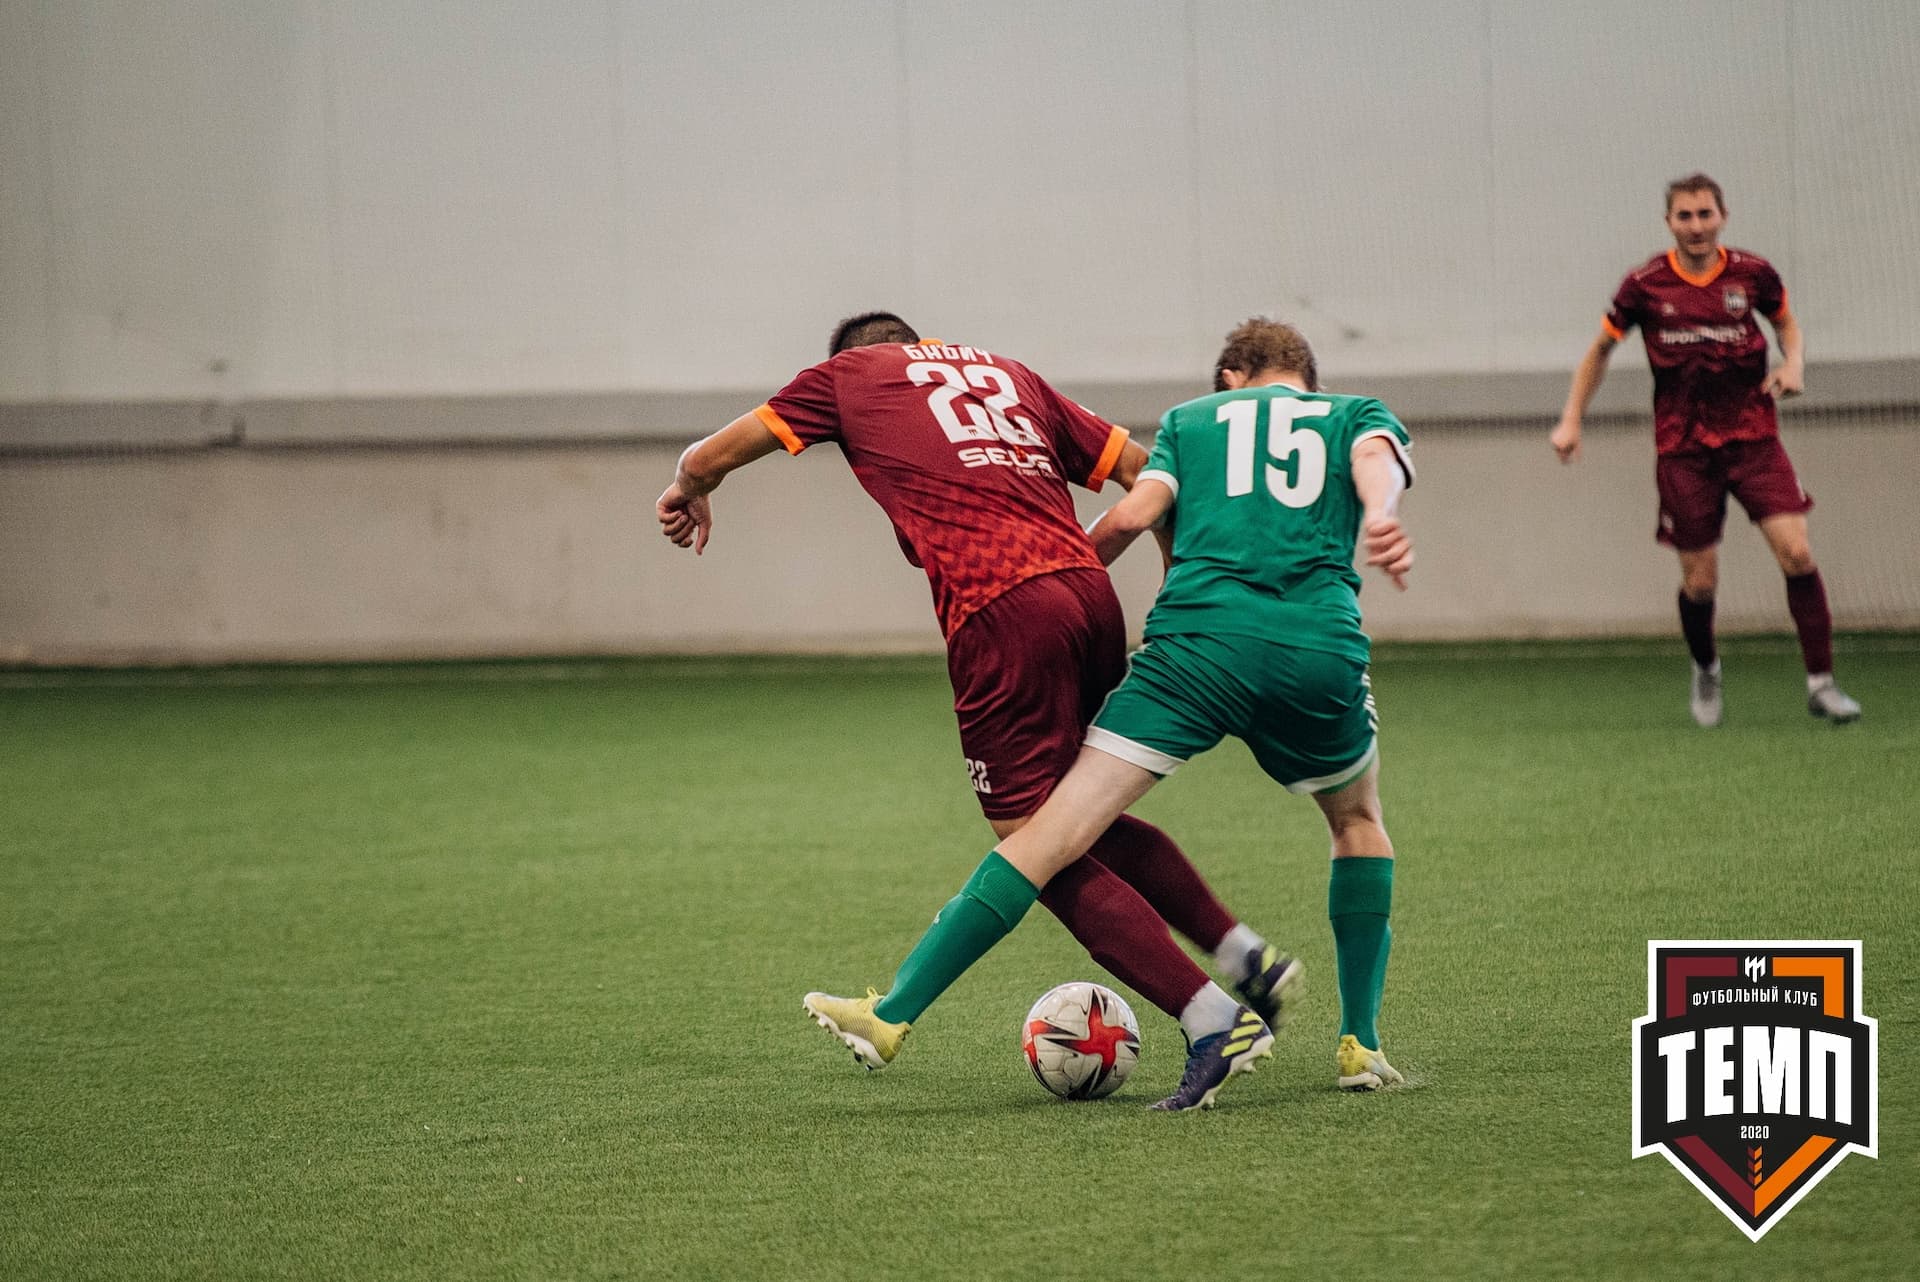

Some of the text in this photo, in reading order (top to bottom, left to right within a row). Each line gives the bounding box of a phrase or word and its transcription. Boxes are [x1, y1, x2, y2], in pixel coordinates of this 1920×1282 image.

[906, 361, 1047, 448] 22
[1216, 397, 1333, 509] 15
[964, 758, 993, 794] 22
